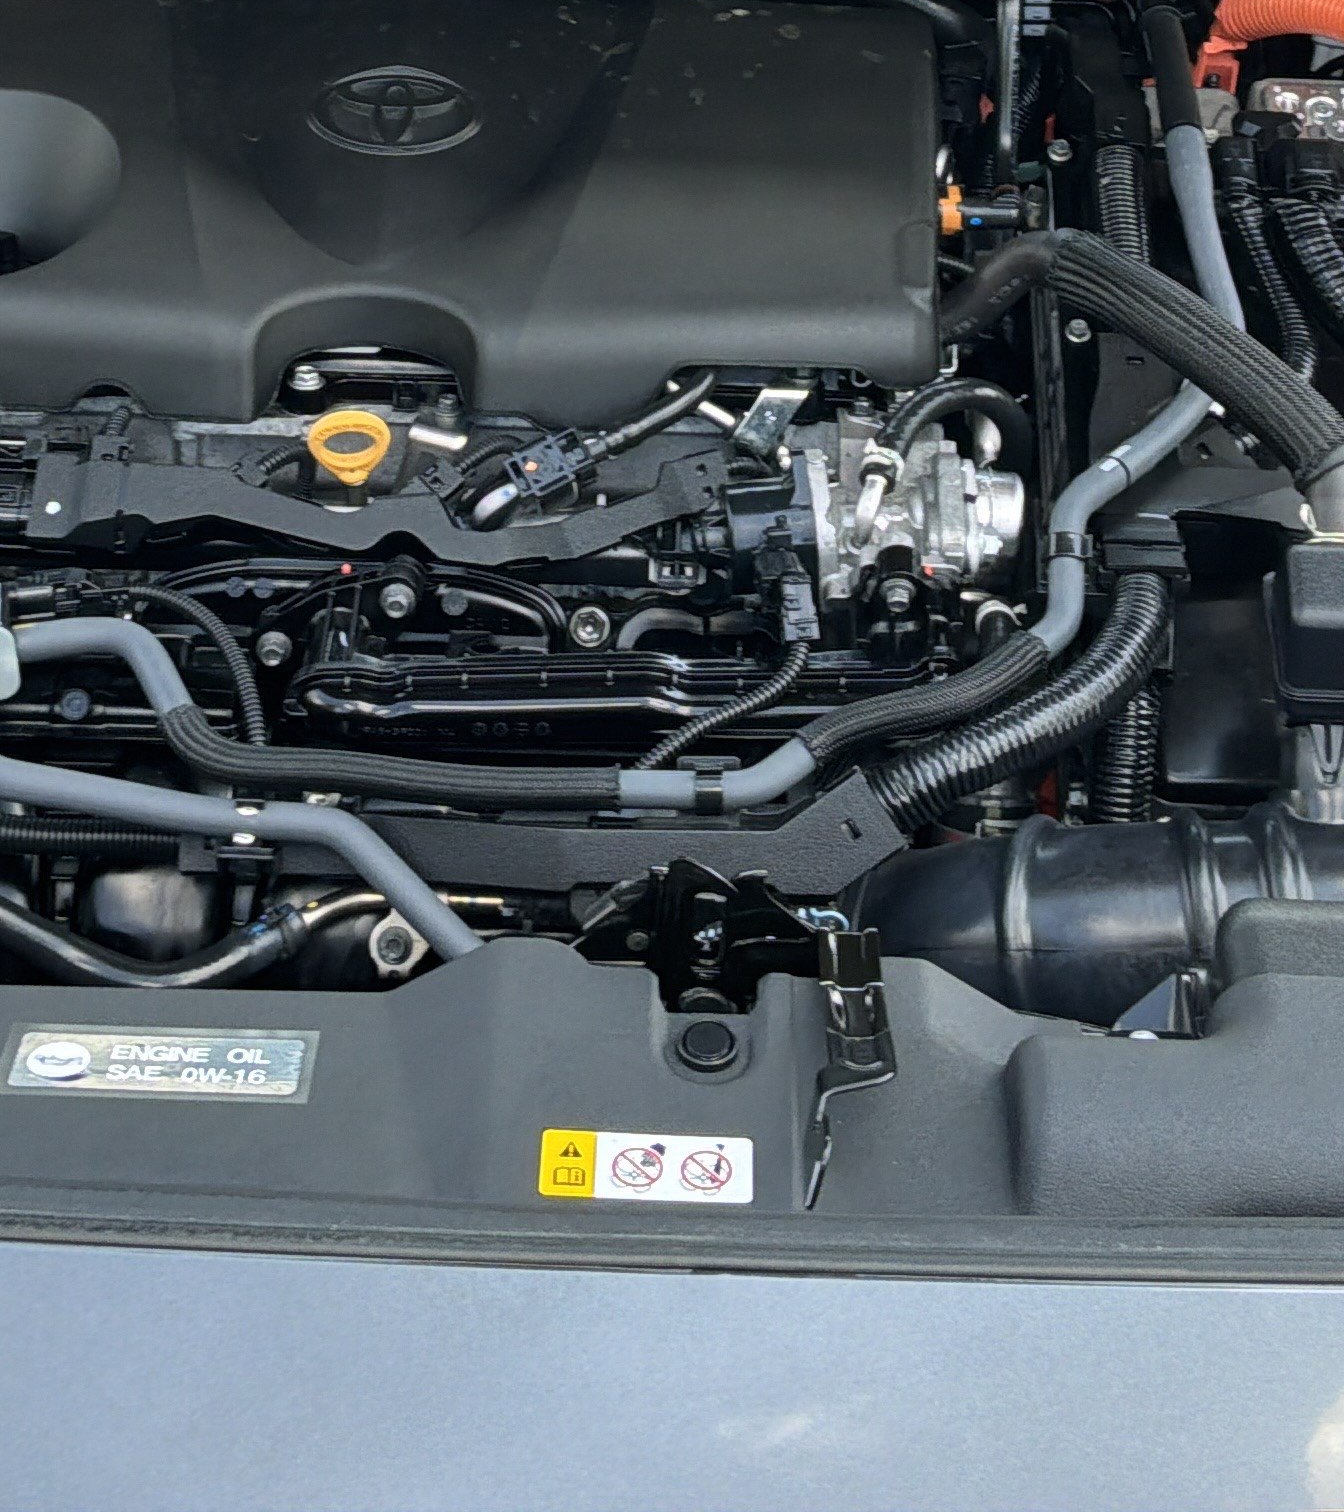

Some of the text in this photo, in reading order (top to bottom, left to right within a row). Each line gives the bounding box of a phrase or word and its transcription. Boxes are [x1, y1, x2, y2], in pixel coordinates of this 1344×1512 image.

[109, 1044, 272, 1065] ENGINE OIL
[106, 1063, 267, 1085] SAE 0W-16
